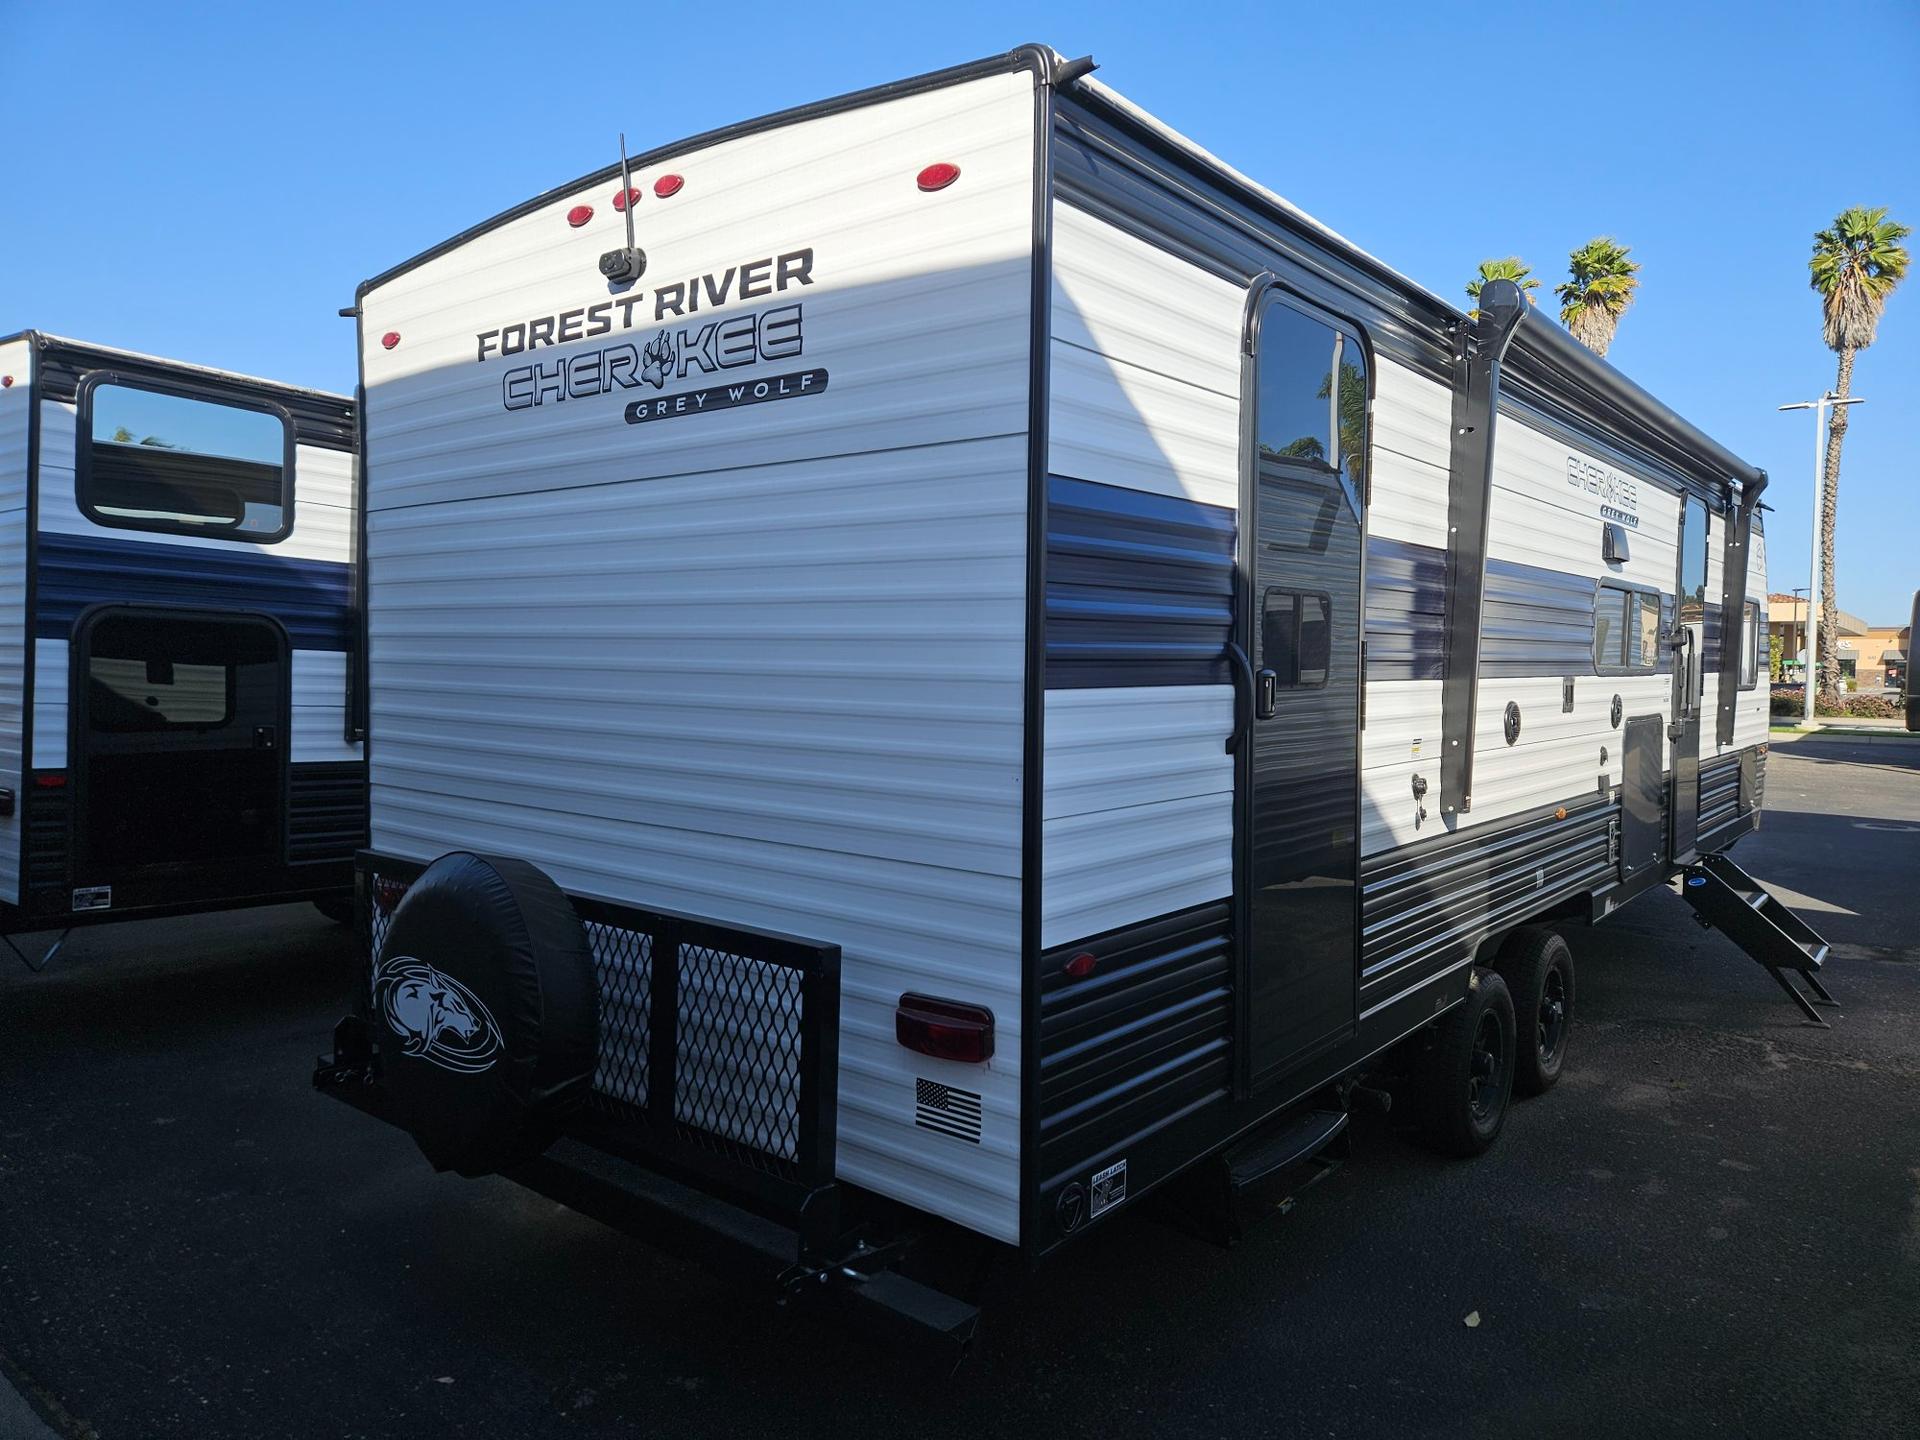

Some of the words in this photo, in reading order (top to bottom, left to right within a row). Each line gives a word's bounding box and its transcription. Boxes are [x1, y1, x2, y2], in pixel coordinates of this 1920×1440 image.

[477, 293, 645, 362] FOREST
[654, 247, 815, 321] RIVER
[635, 391, 708, 419] GREY
[729, 373, 815, 404] WOLF
[1093, 1169, 1110, 1184] LEASH
